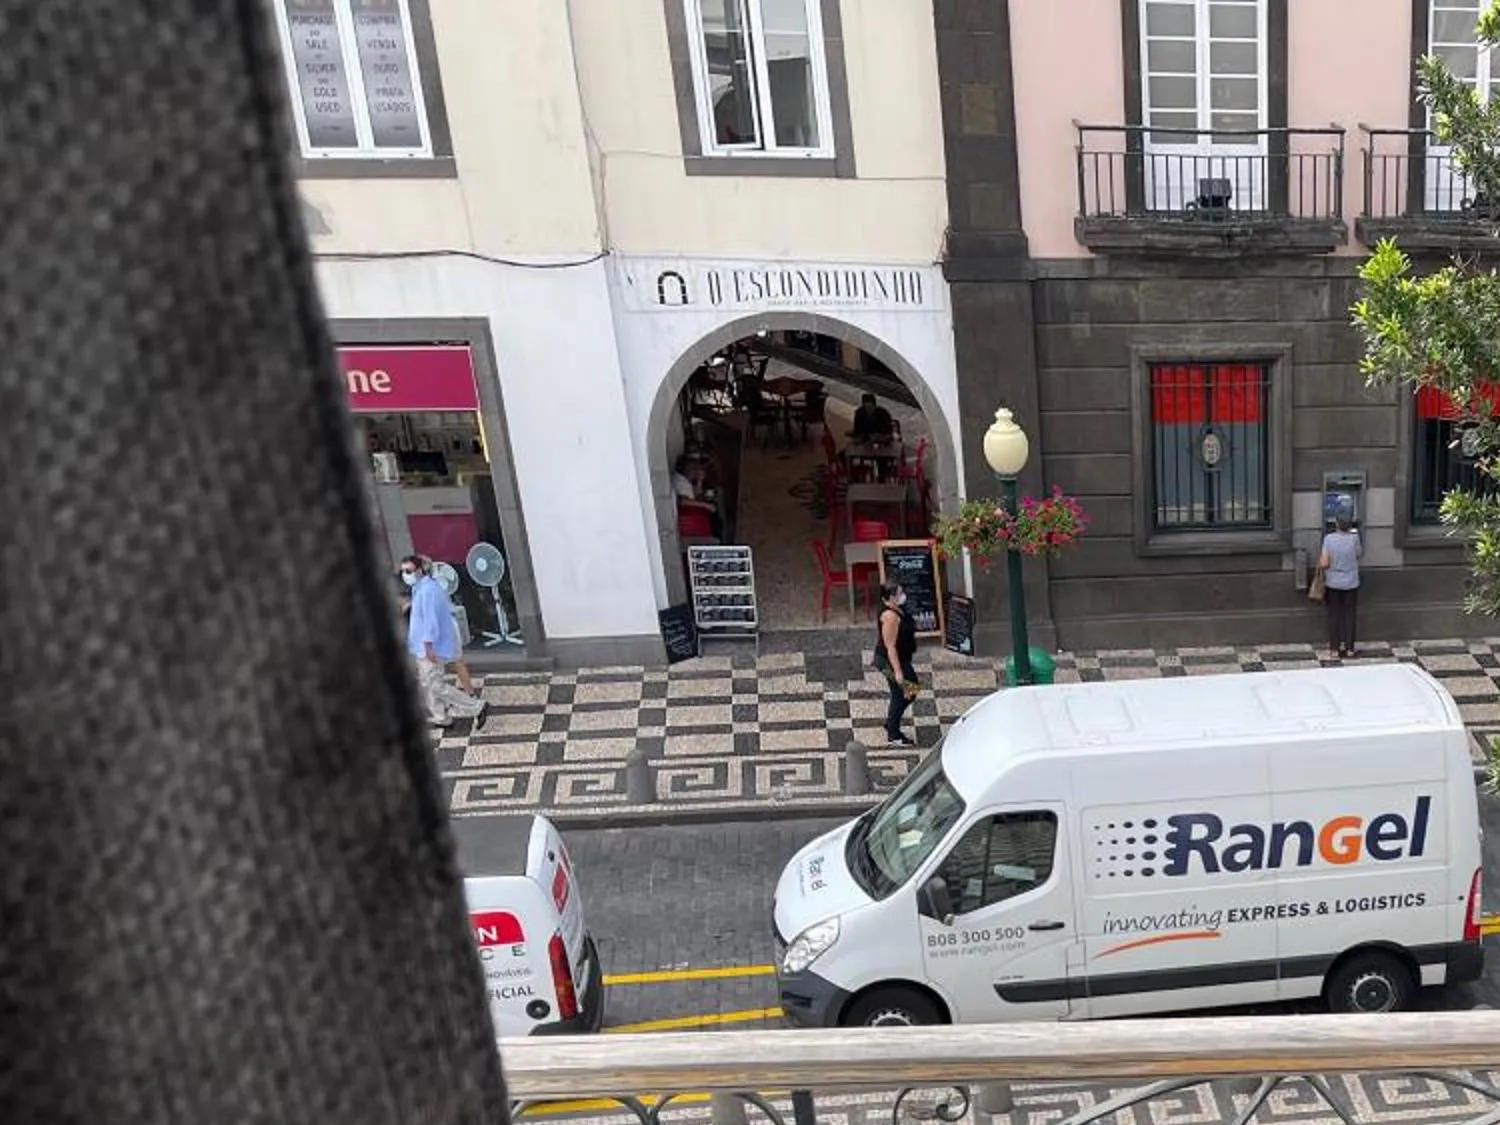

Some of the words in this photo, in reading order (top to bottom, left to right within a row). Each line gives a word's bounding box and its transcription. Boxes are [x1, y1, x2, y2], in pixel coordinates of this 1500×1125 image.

[313, 87, 338, 97] GOLD
[316, 103, 342, 113] USED
[707, 271, 723, 306] O
[733, 270, 923, 305] ESCONDIDINHO
[1103, 904, 1224, 933] innovating
[1227, 901, 1311, 923] EXPRESS
[1316, 902, 1329, 916] &
[1335, 893, 1427, 914] LOGISTICS
[928, 934, 957, 947] 808
[961, 930, 990, 944] 300
[995, 927, 1024, 940] 500
